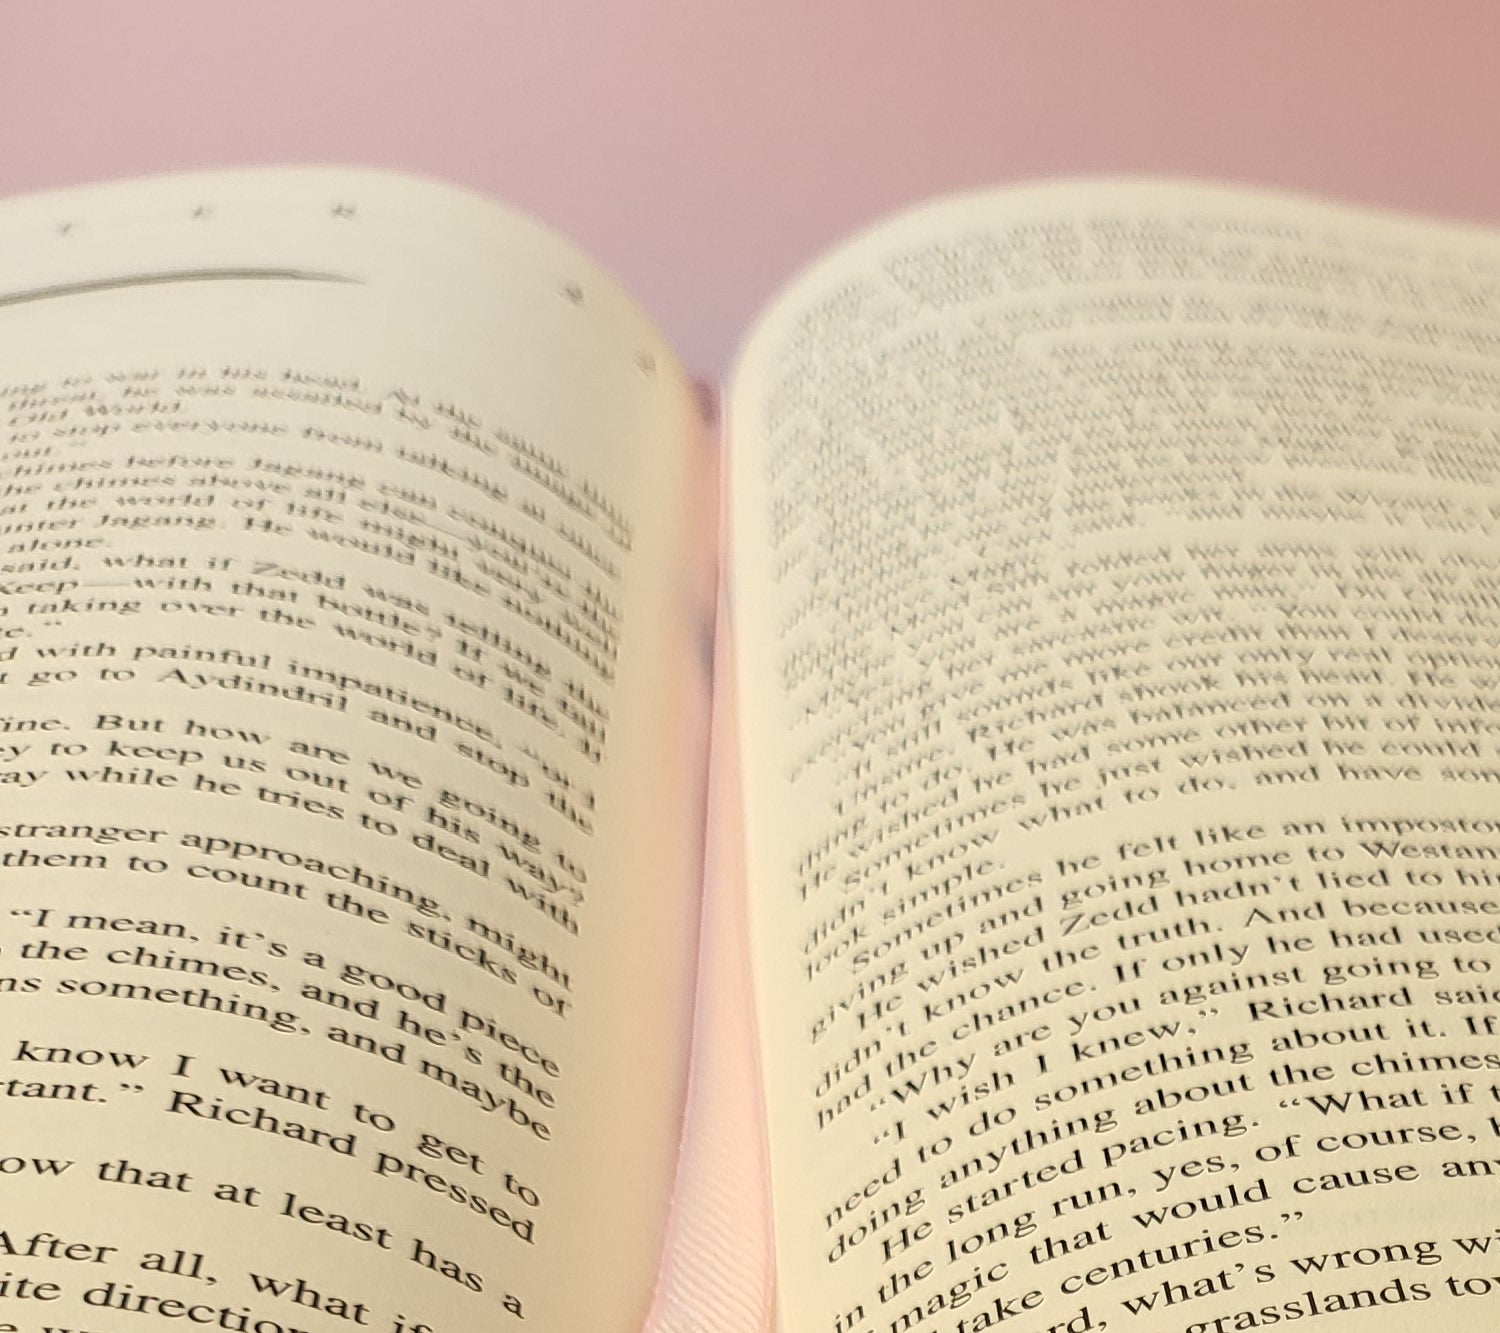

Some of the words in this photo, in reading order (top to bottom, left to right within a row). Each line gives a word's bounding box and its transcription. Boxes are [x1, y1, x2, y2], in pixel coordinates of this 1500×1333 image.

[2, 849, 107, 869] them
[128, 856, 169, 872] to
[186, 865, 305, 899] count
[326, 892, 389, 924] the
[407, 921, 517, 985] sticks
[180, 834, 451, 921] approaching,
[1161, 942, 1249, 971] only
[1265, 934, 1313, 955] he
[1328, 924, 1403, 948] had
[10, 908, 50, 927] “I
[68, 915, 199, 942] mean,
[219, 926, 287, 957] it’s
[302, 952, 325, 969] a
[340, 964, 446, 1013] good
[460, 1010, 559, 1077] piece
[20, 940, 88, 961] the
[106, 946, 280, 991] chimes,
[300, 984, 380, 1019] and
[398, 1010, 482, 1065] he’s
[499, 1062, 555, 1108] the
[56, 980, 310, 1034] something,
[327, 1026, 406, 1064] and
[421, 1059, 550, 1141] maybe
[993, 1024, 1050, 1057] are
[1067, 997, 1141, 1030] you
[1158, 965, 1302, 1006] against
[1321, 956, 1439, 985] going
[1451, 955, 1492, 973] to
[1247, 985, 1413, 1022] Richard
[16, 1040, 148, 1069] know
[175, 1054, 191, 1077] I
[219, 1068, 326, 1110] want
[354, 1104, 396, 1132] to
[416, 1133, 480, 1174] get
[504, 1173, 540, 1207] to
[168, 1090, 357, 1157] Richard
[375, 1152, 534, 1244] pressed
[825, 1157, 901, 1228] need
[917, 1136, 953, 1163] to
[968, 1107, 1016, 1136] do
[1035, 1042, 1252, 1106] something
[1271, 1023, 1385, 1051] about
[1406, 1018, 1441, 1038] it.
[1465, 1015, 1494, 1035] If
[827, 1189, 925, 1264] doing
[940, 1109, 1117, 1189] anything
[1135, 1074, 1249, 1115] about
[1269, 1063, 1332, 1086] the
[882, 1221, 931, 1261] He
[948, 1148, 1084, 1224] started
[1102, 1114, 1258, 1168] pacing.
[1279, 1088, 1423, 1115] “What
[1441, 1083, 1472, 1105] if
[98, 1159, 190, 1193] that
[213, 1183, 257, 1207] at
[281, 1192, 389, 1249] least
[411, 1238, 483, 1293] has
[502, 1294, 524, 1319] a
[139, 1249, 217, 1284] all,
[249, 1273, 368, 1325] what
[878, 1260, 932, 1304] the
[947, 1212, 1037, 1262] long
[1052, 1182, 1136, 1217] run,
[1153, 1155, 1240, 1192] yes,
[1255, 1136, 1296, 1162] of
[1316, 1125, 1476, 1152] course,
[1029, 1222, 1108, 1265] that
[1132, 1178, 1270, 1228] would
[1293, 1165, 1418, 1194] cause
[1060, 1210, 1303, 1295] centuries.”
[1121, 1262, 1276, 1315] what’s
[1290, 1241, 1442, 1275] wrong
